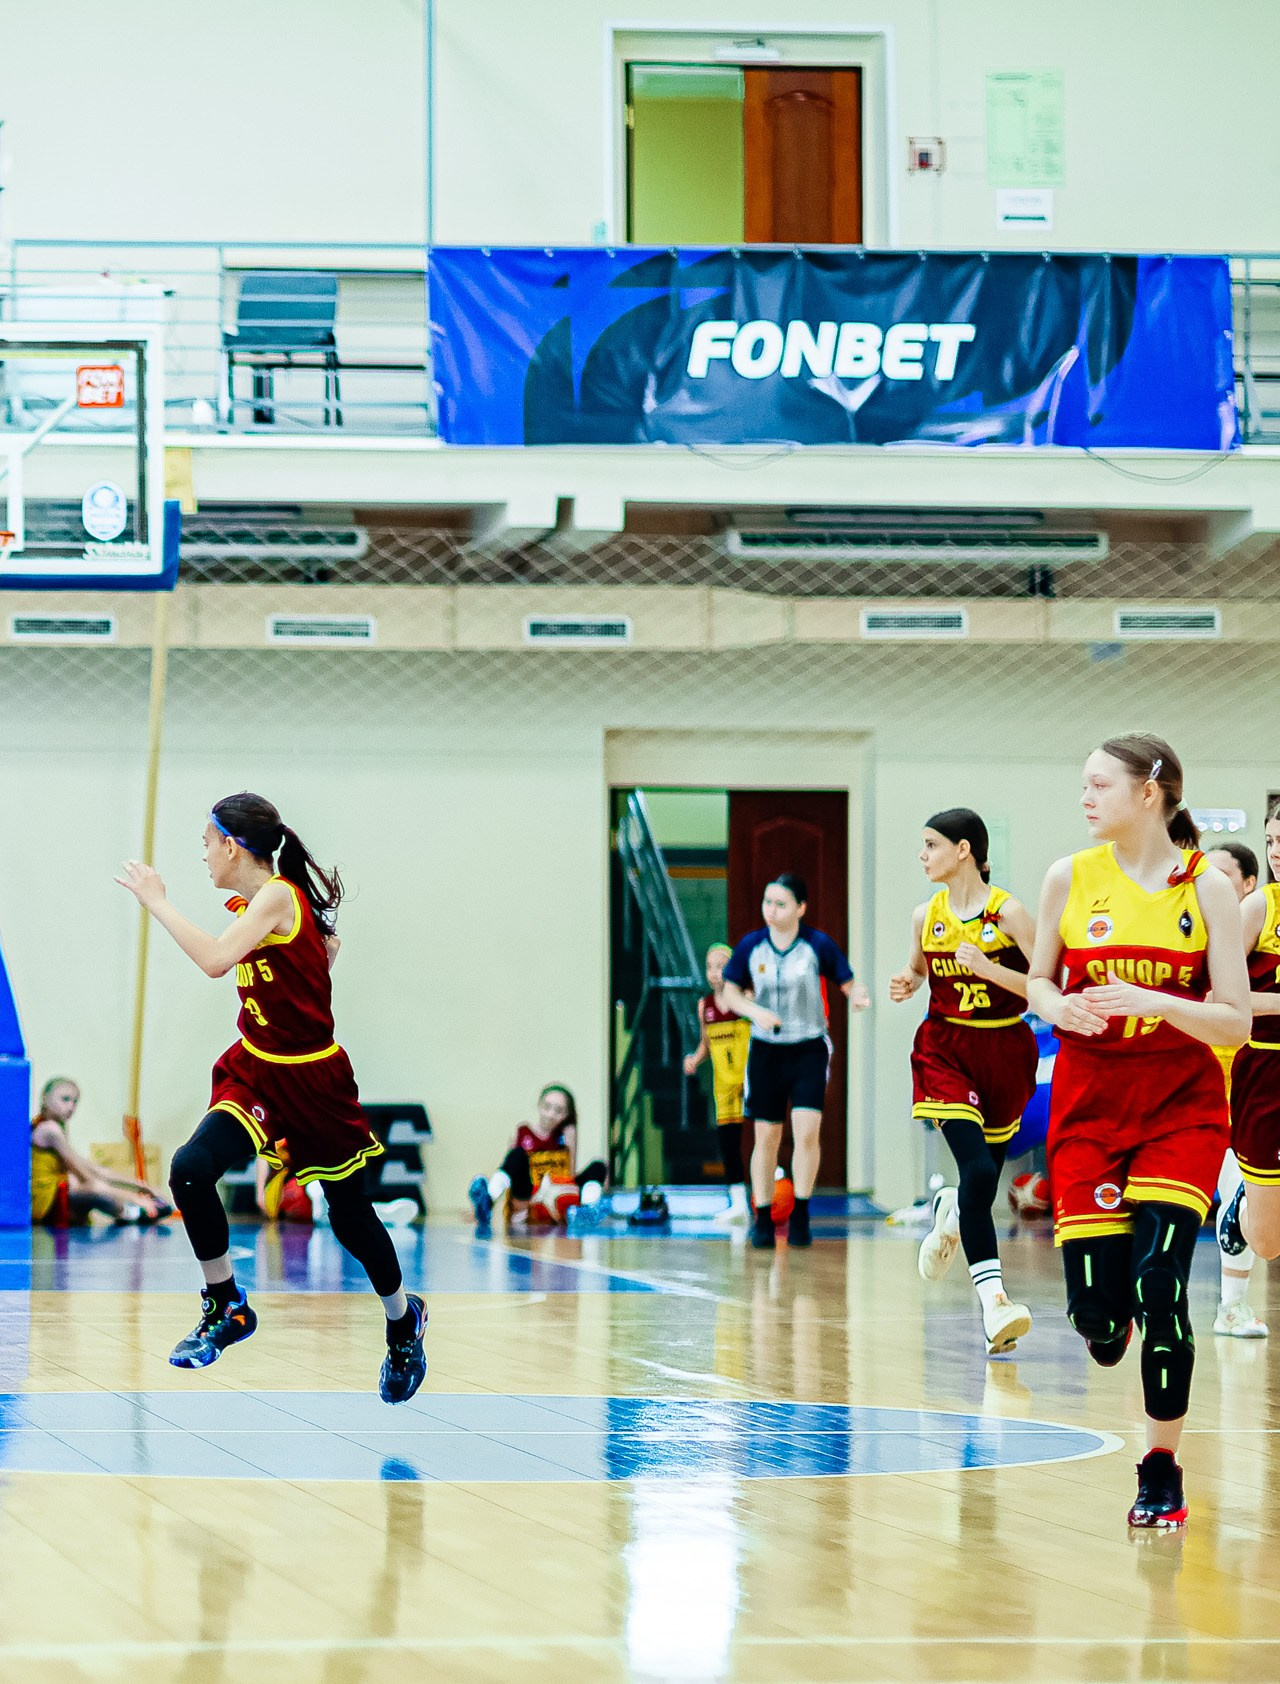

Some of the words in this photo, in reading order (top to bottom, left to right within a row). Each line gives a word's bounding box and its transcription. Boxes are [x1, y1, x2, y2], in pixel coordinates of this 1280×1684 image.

[686, 319, 977, 381] FONBET
[255, 958, 274, 982] 5
[1086, 958, 1172, 986] СШОР
